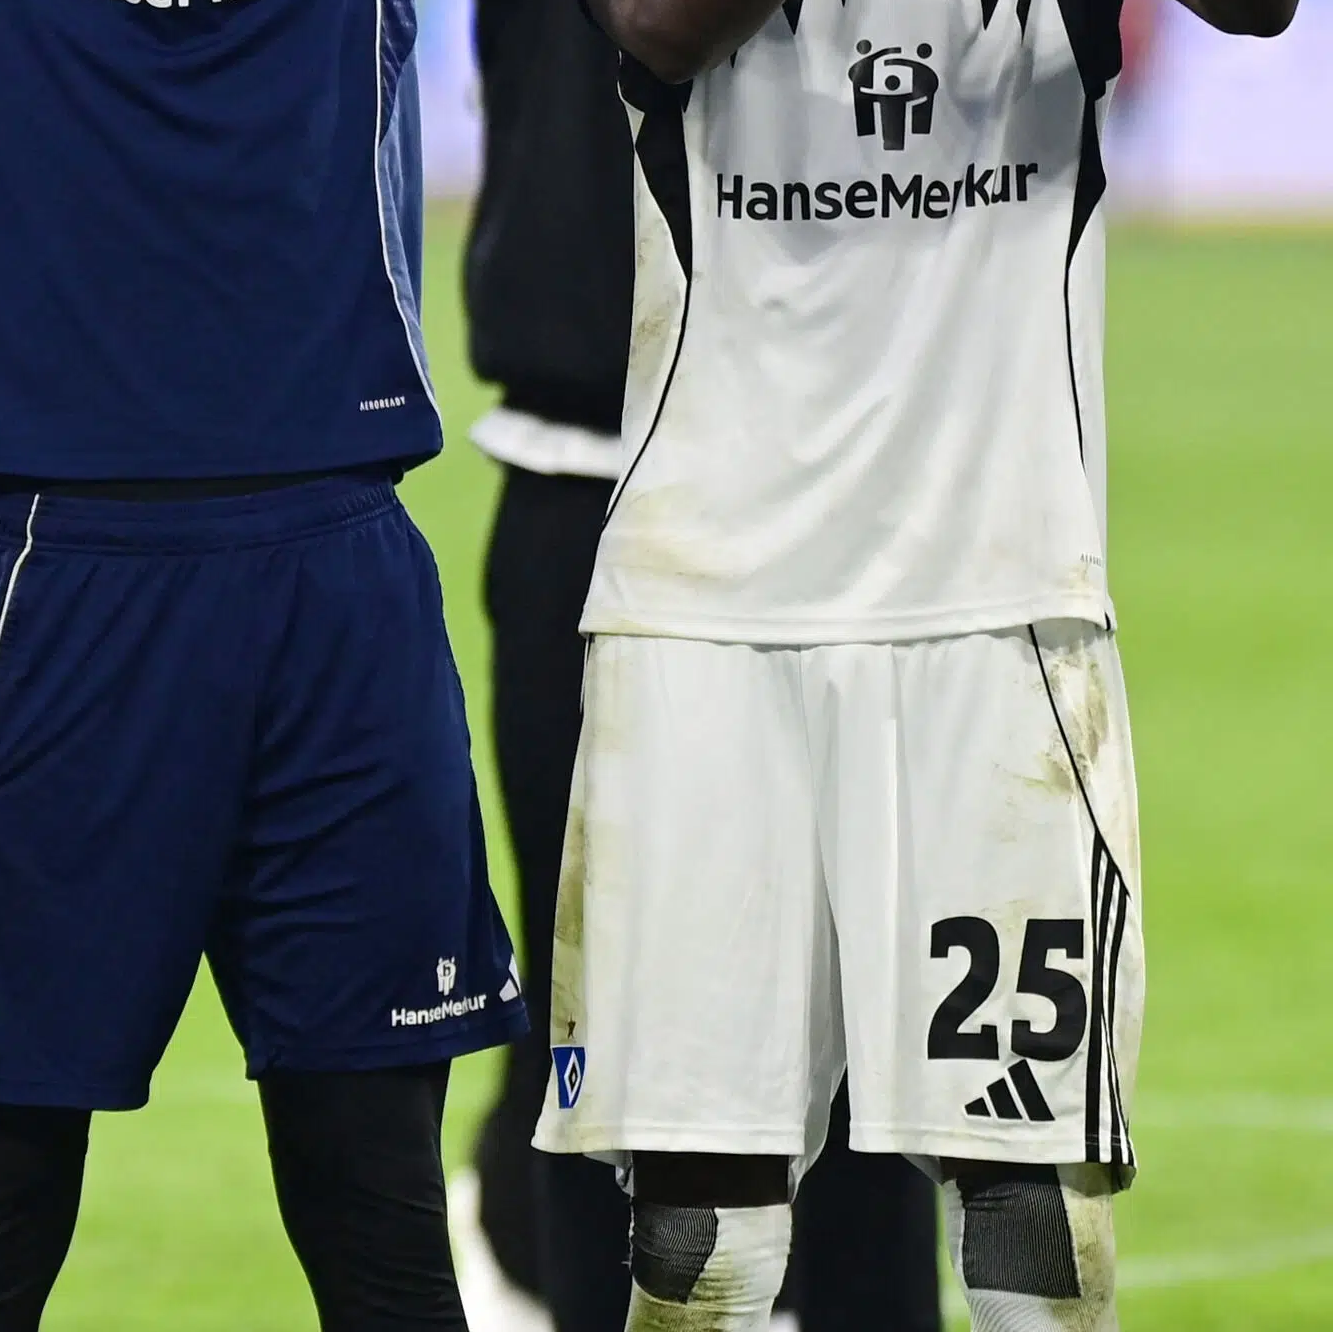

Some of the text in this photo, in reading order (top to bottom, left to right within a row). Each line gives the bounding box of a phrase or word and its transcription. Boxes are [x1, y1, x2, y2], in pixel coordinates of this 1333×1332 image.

[717, 163, 1038, 221] HanseMerkur
[359, 396, 405, 411] AEROREADY
[927, 916, 1088, 1062] 25
